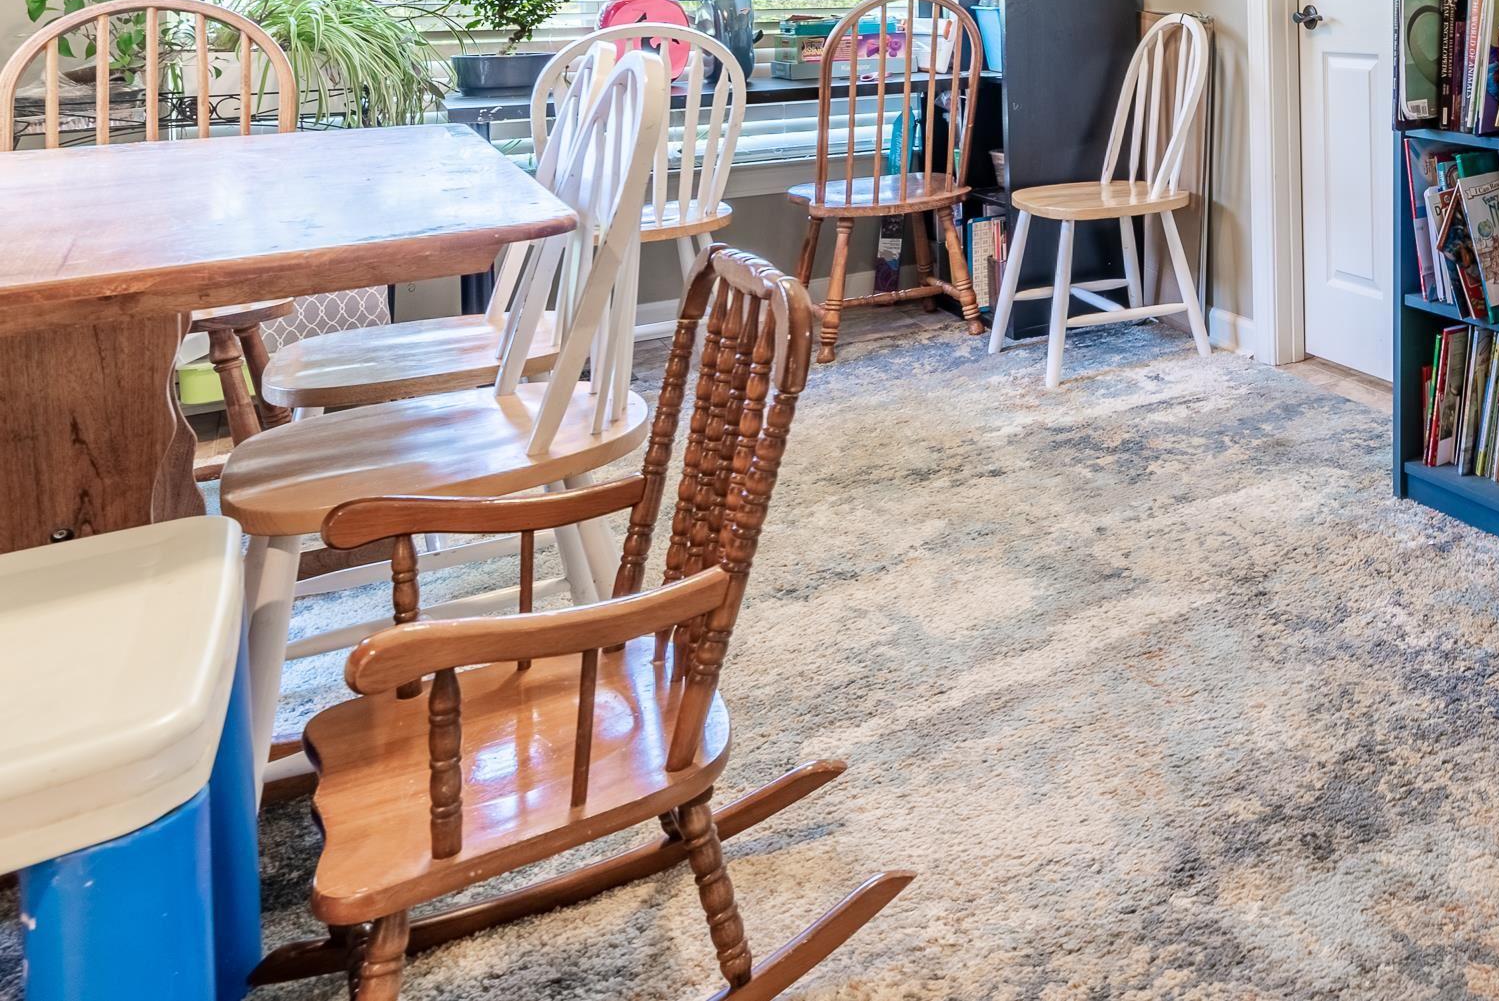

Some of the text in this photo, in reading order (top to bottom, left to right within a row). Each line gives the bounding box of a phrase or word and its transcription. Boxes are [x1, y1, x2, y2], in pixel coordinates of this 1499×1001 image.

[1468, 14, 1479, 48] WORLD
[1440, 21, 1449, 78] ENCYCLOPEDIA
[1467, 47, 1476, 59] OF
[1466, 61, 1475, 99] ANIMALS
